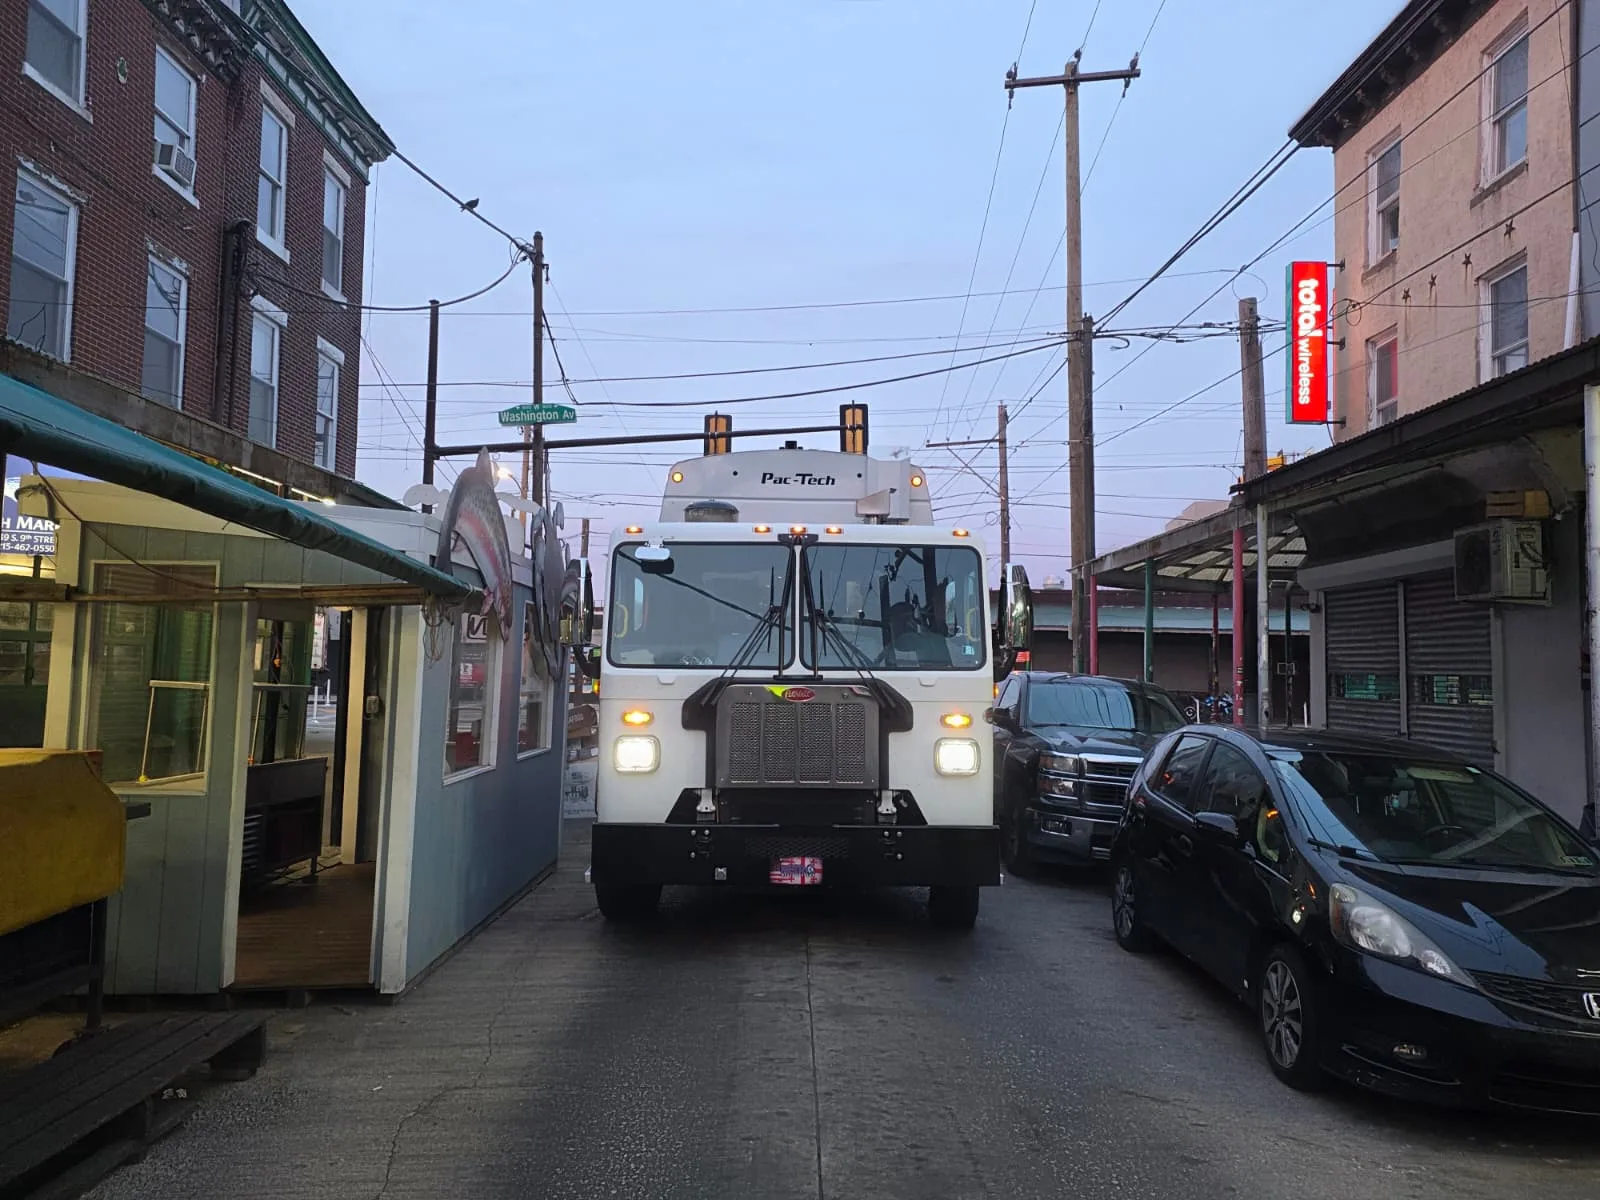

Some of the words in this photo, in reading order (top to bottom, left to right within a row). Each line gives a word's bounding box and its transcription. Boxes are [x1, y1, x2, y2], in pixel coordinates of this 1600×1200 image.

[1298, 278, 1323, 337] total
[1298, 338, 1314, 405] wireless
[501, 409, 559, 423] Washington
[562, 410, 575, 420] Av
[761, 472, 836, 486] Pac-Tech
[16, 516, 60, 531] MAR
